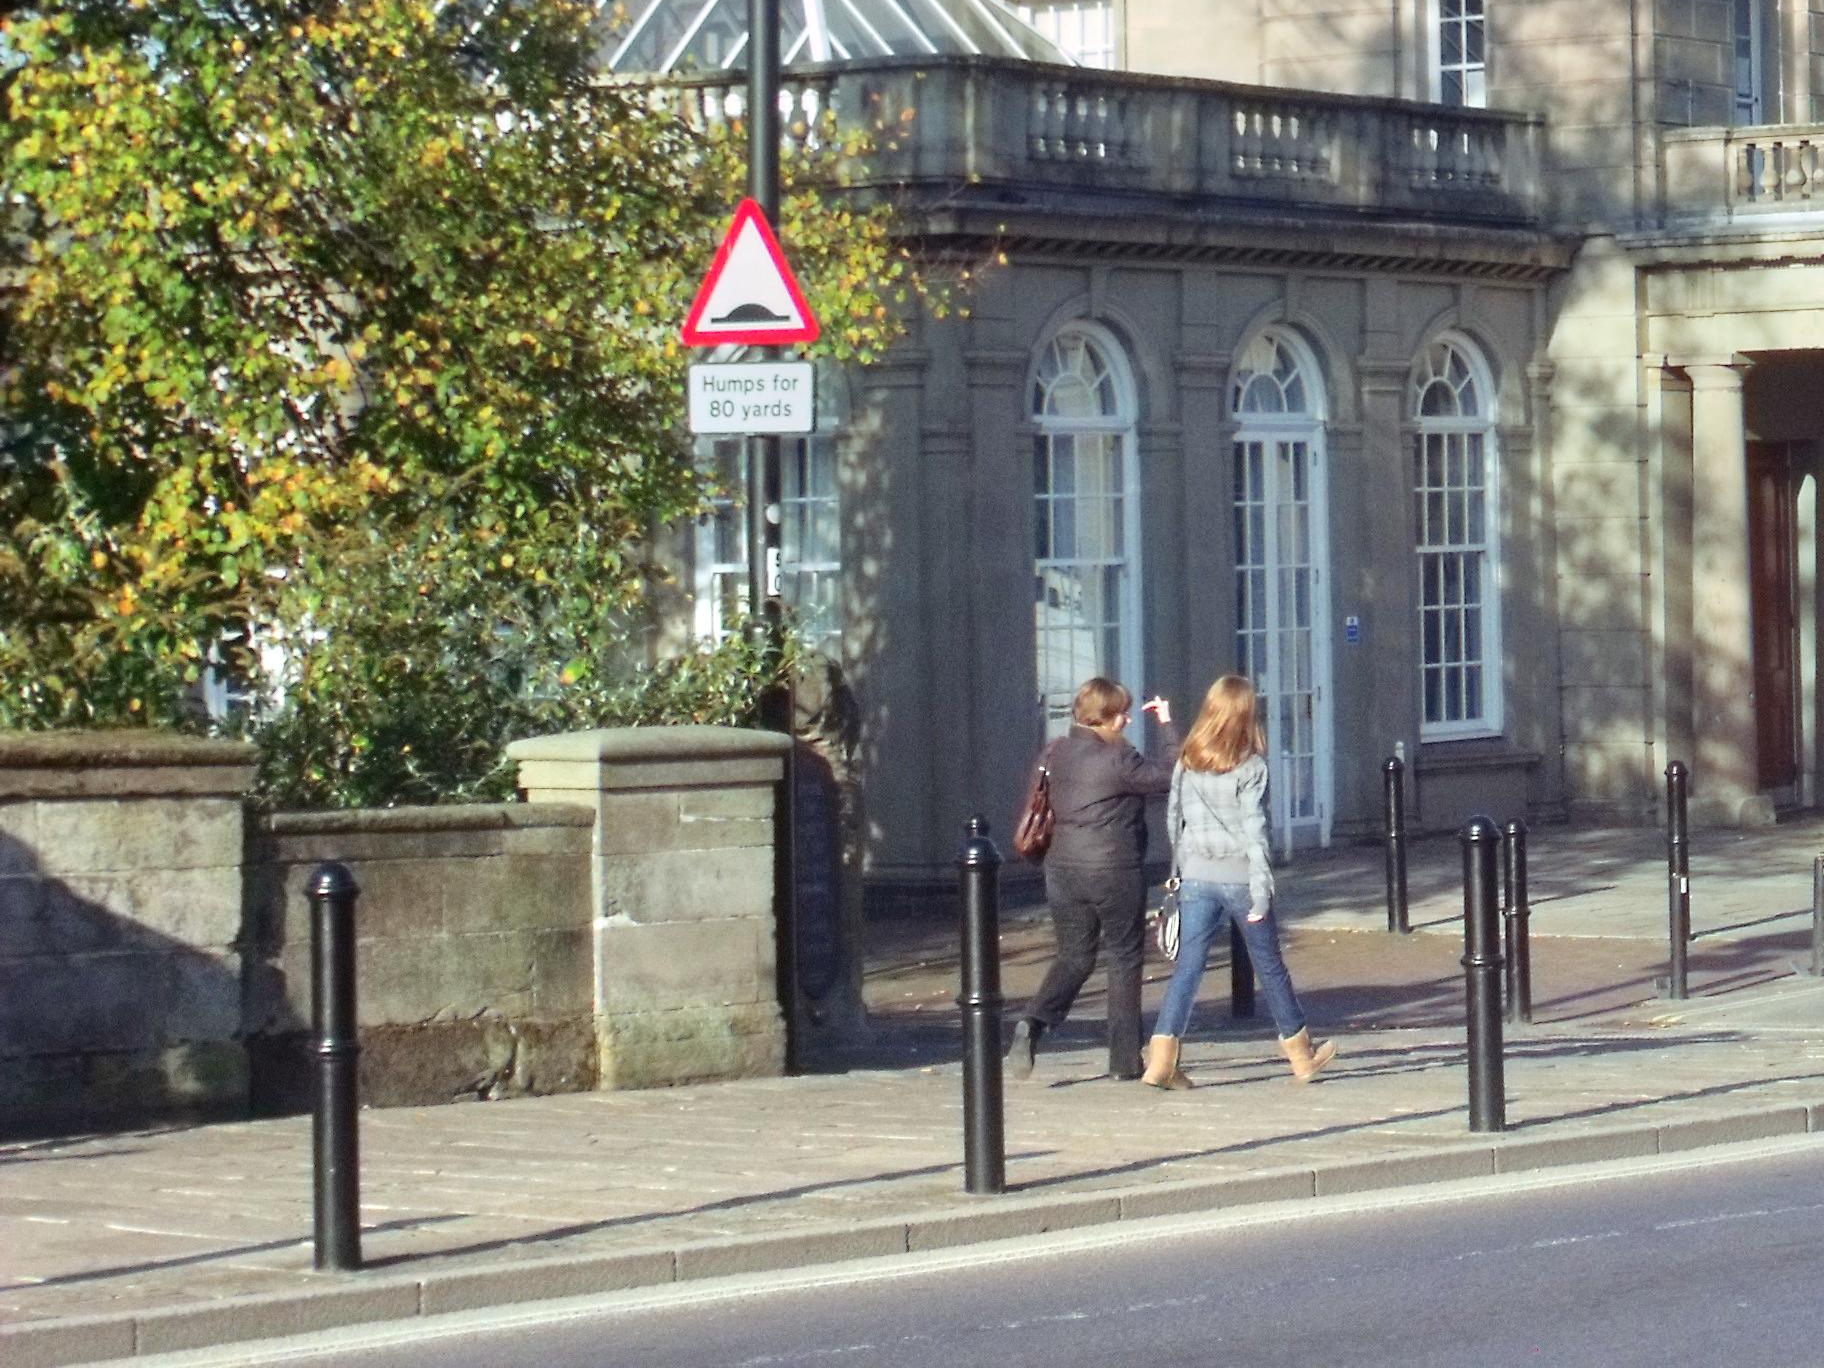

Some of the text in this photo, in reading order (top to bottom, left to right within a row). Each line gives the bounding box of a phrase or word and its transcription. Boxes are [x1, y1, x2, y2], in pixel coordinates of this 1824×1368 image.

[703, 374, 799, 395] Humps for
[710, 399, 792, 421] 80 yards
